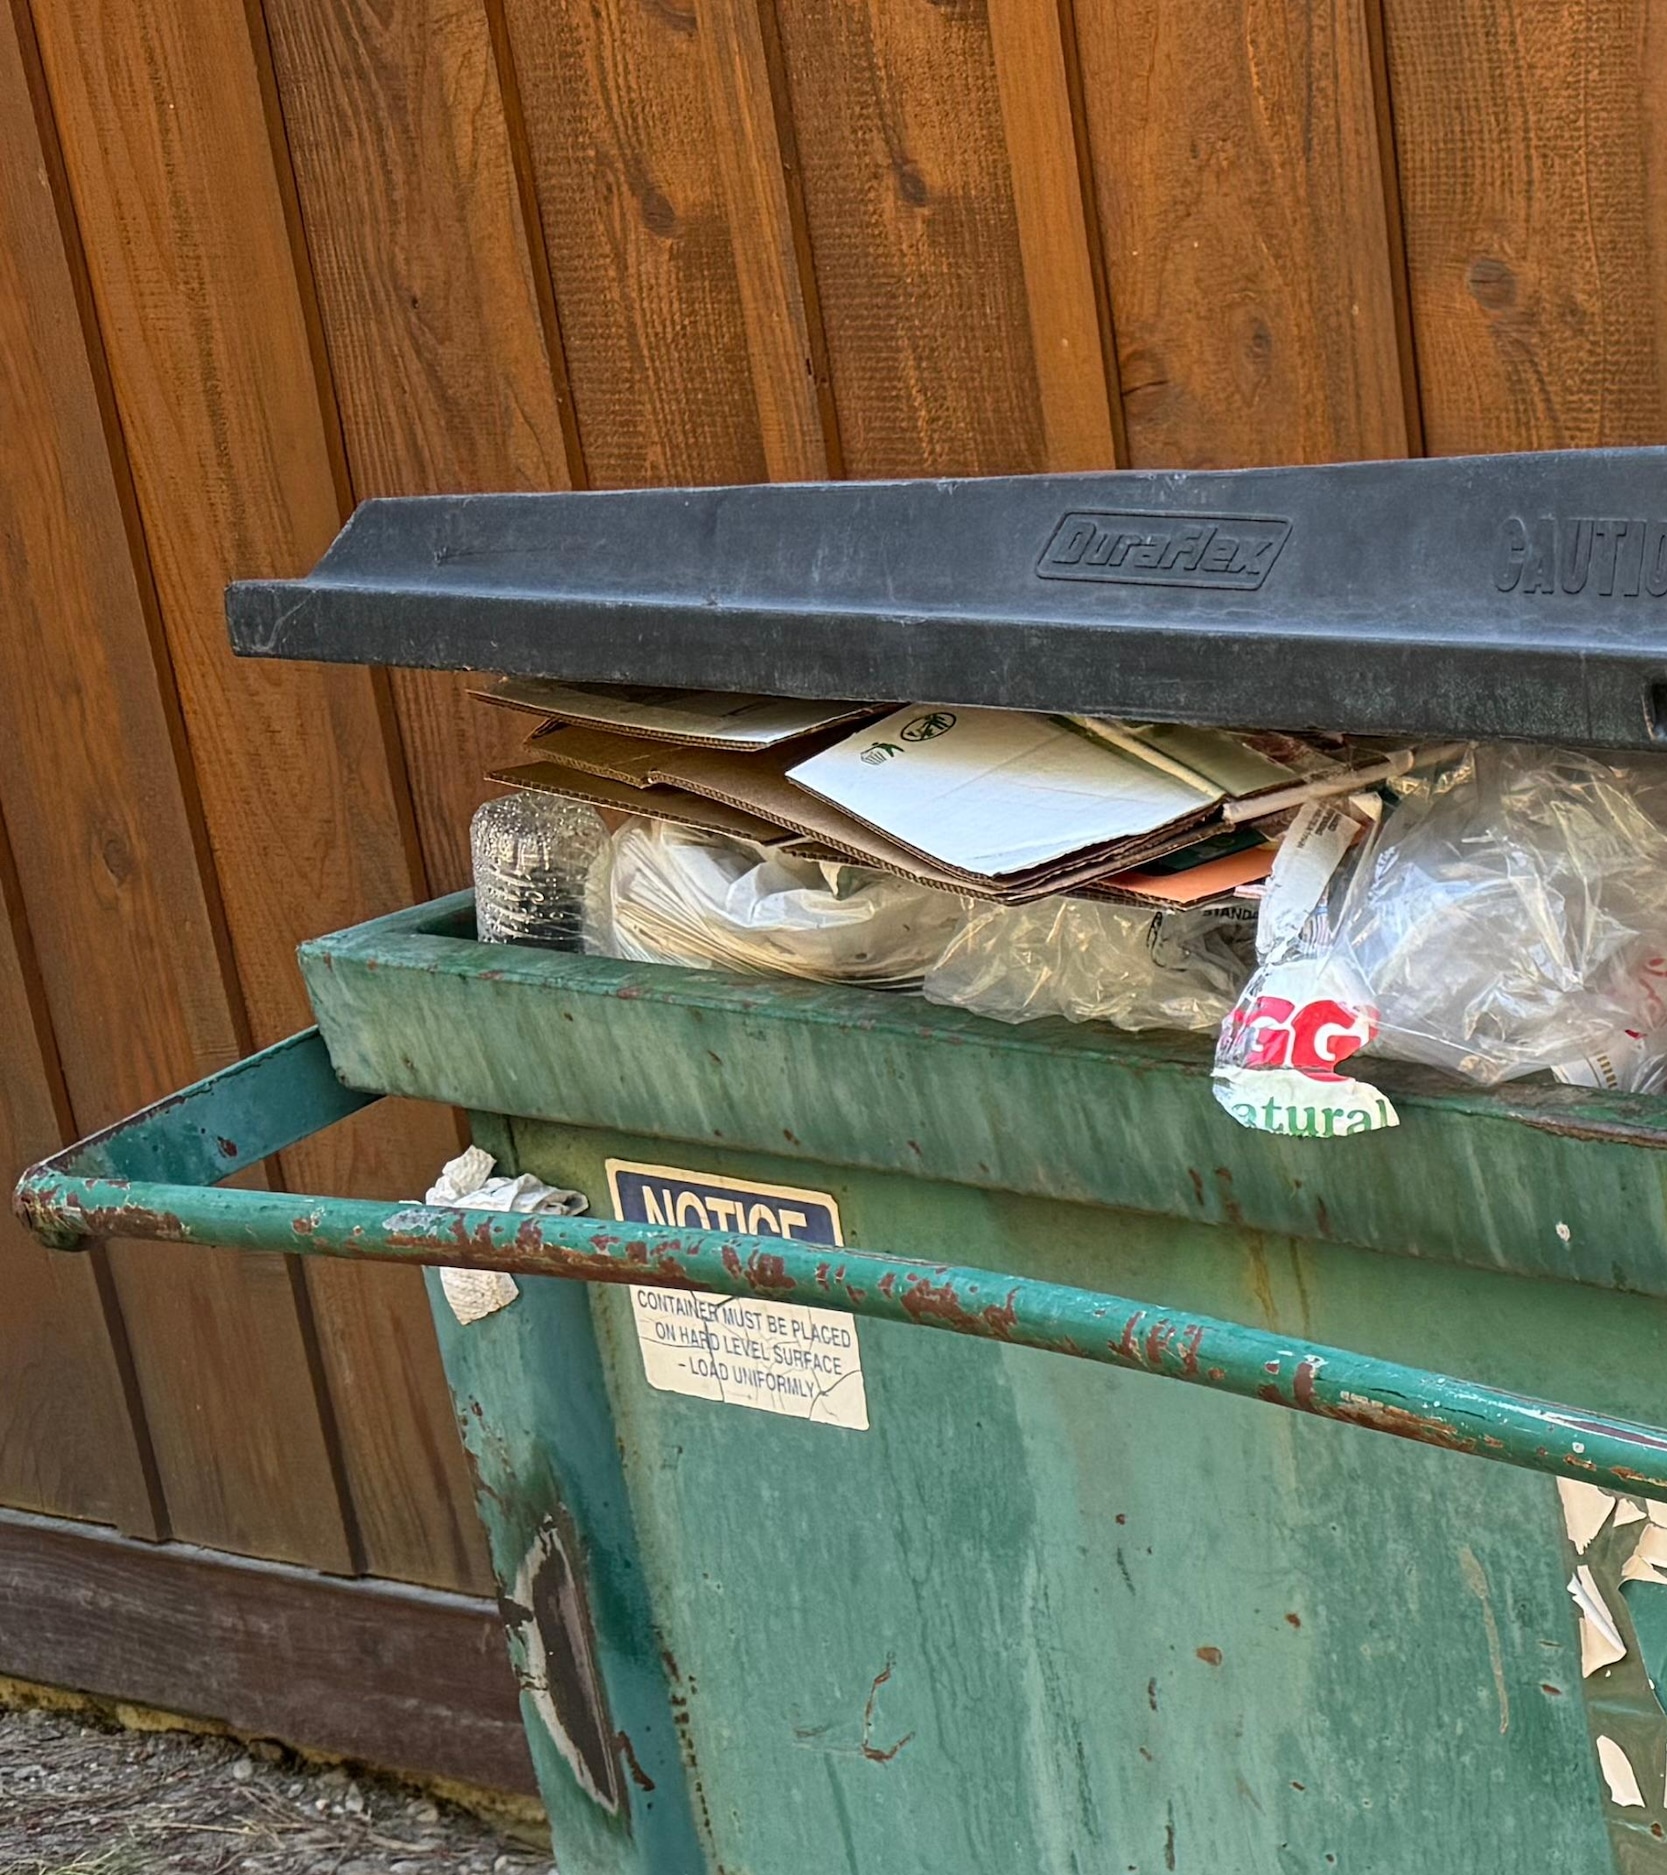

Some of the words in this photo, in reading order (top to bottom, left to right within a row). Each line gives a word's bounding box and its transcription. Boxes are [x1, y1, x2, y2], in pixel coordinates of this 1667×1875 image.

[637, 1290, 718, 1322] CONTAINER
[723, 1307, 762, 1331] MUST
[768, 1315, 788, 1336] BE
[791, 1319, 851, 1348] PLACED
[655, 1322, 676, 1342] ON
[680, 1326, 720, 1351] HARD
[725, 1334, 770, 1362] LEVEL
[774, 1345, 843, 1376] SURFACE
[690, 1356, 729, 1381] LOAD
[733, 1366, 815, 1398] UNIFORMLY
